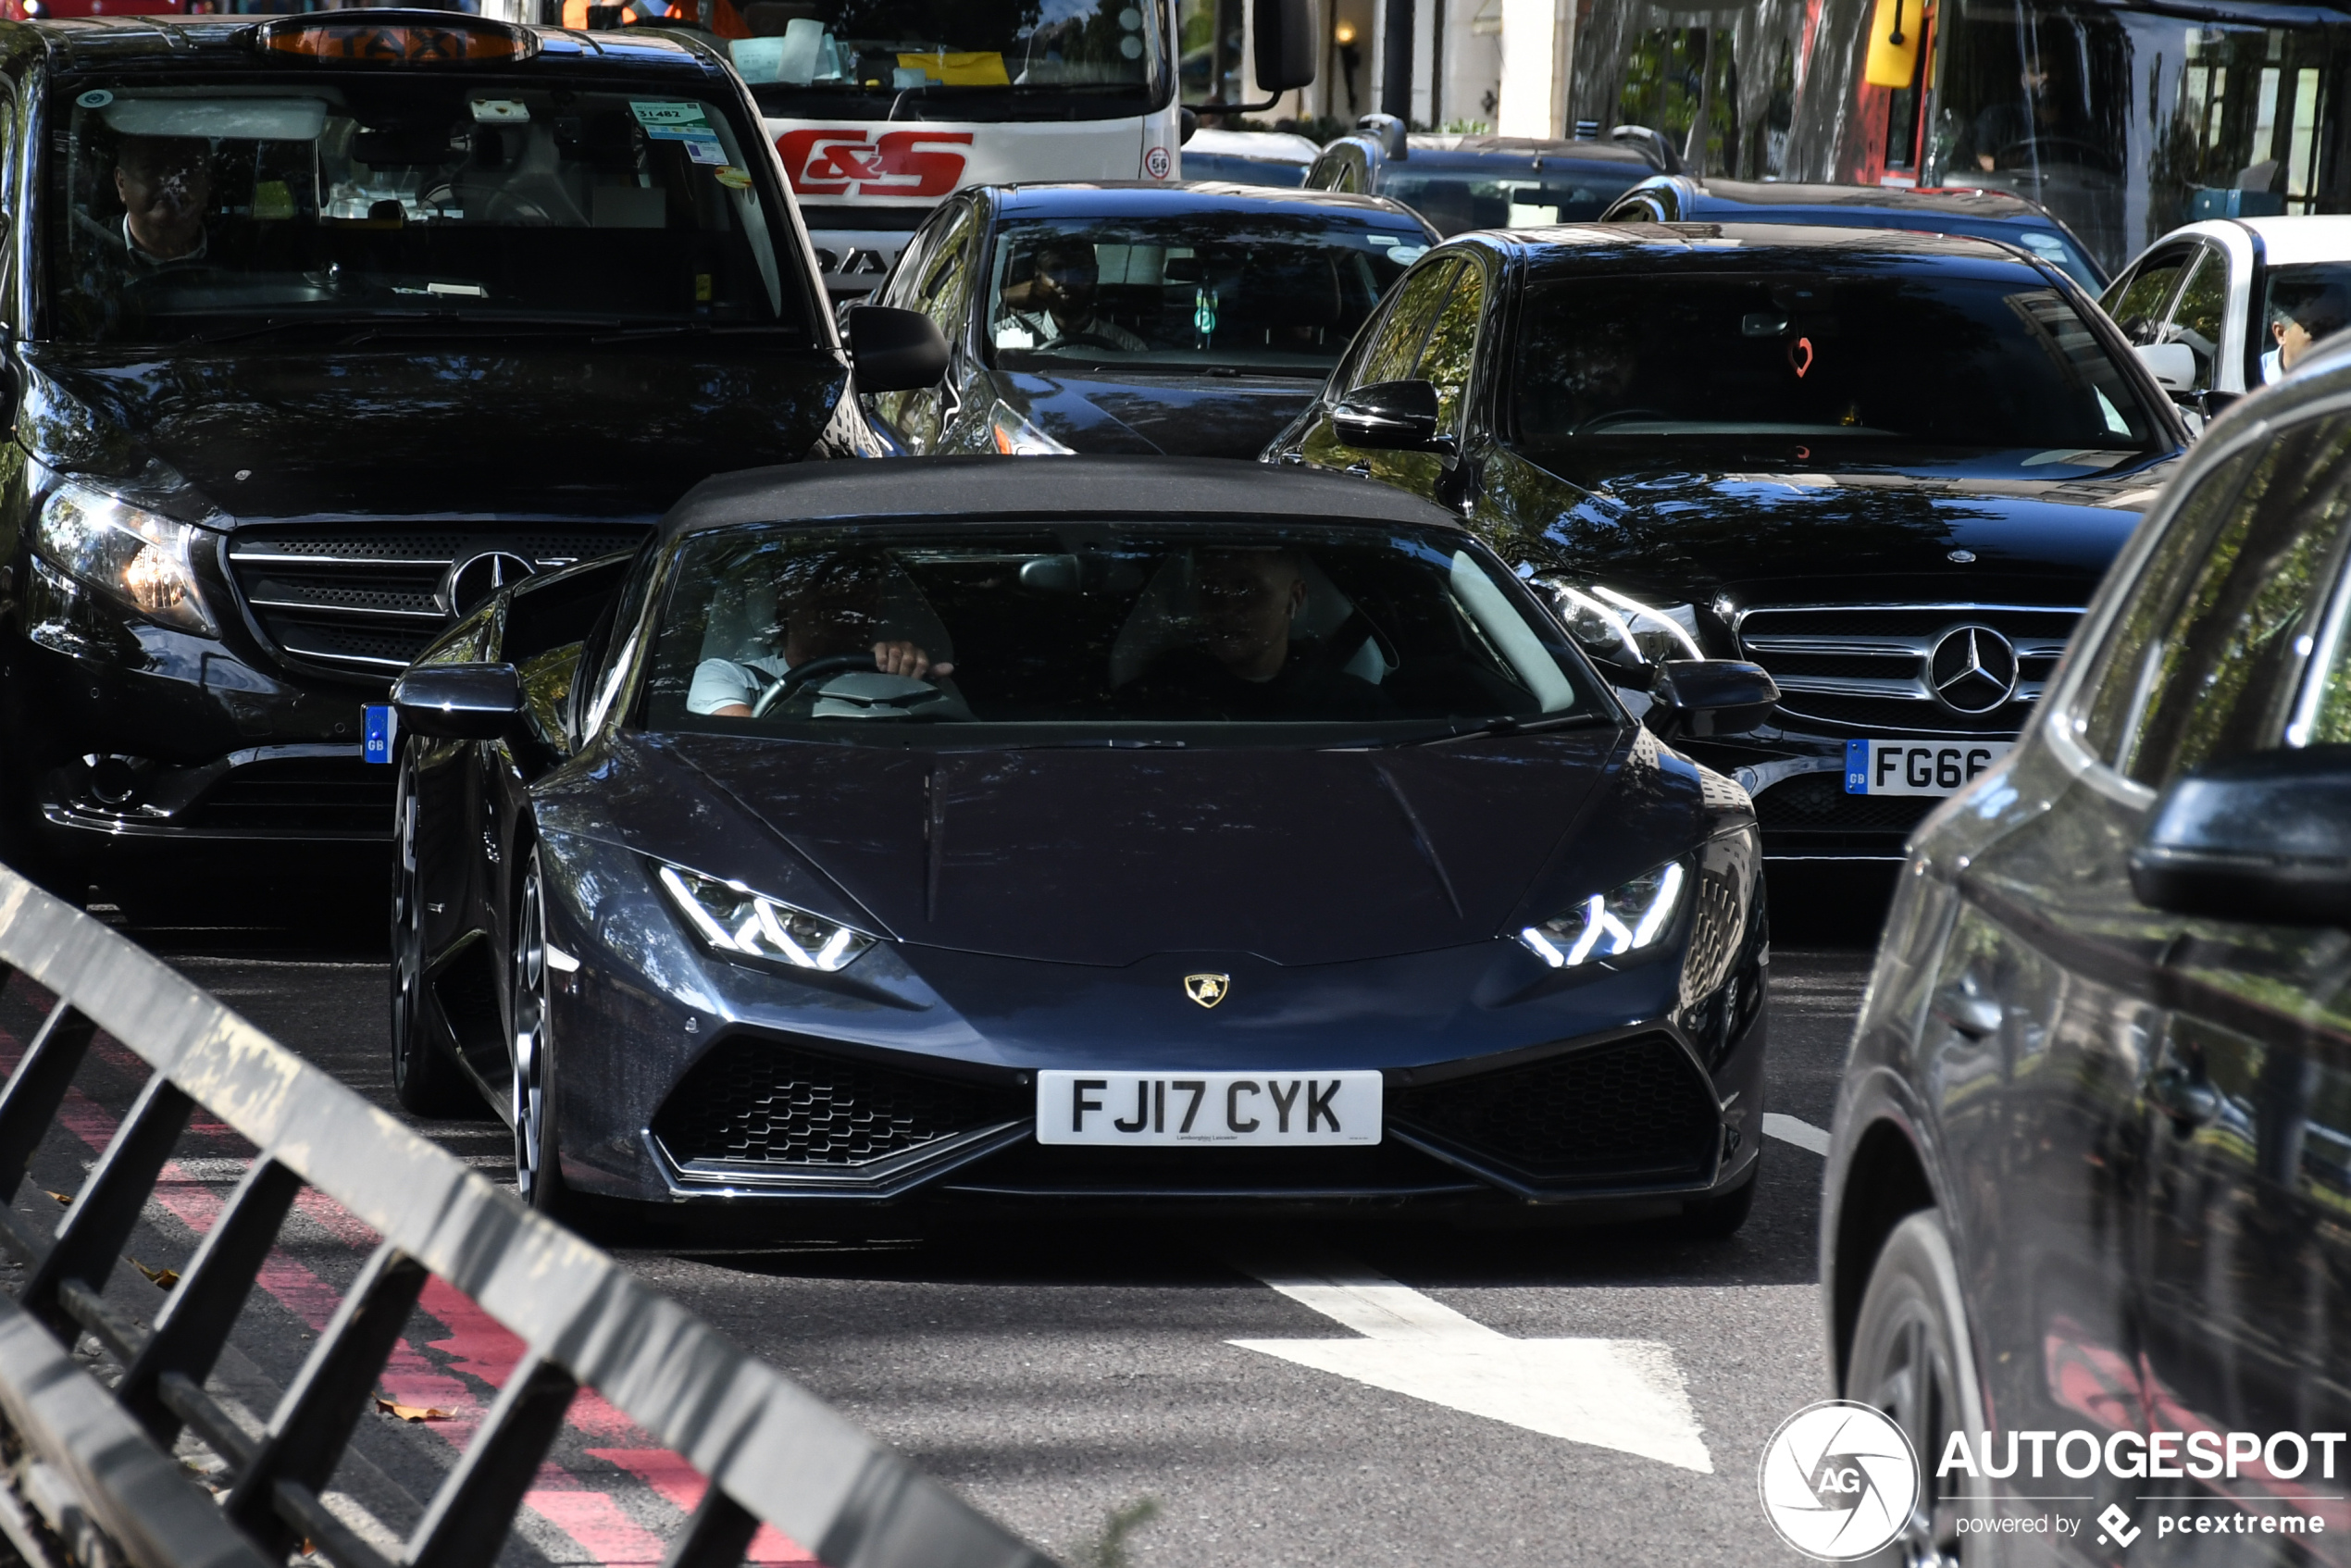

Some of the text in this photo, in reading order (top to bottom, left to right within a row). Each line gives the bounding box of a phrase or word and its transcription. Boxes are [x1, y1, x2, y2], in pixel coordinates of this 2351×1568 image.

[328, 29, 467, 57] TAXI
[1152, 157, 1167, 169] 56
[368, 740, 384, 751] GB
[1876, 747, 1992, 789] FG66
[1849, 773, 1865, 784] GB
[1073, 1079, 1342, 1134] FJ17 CYK
